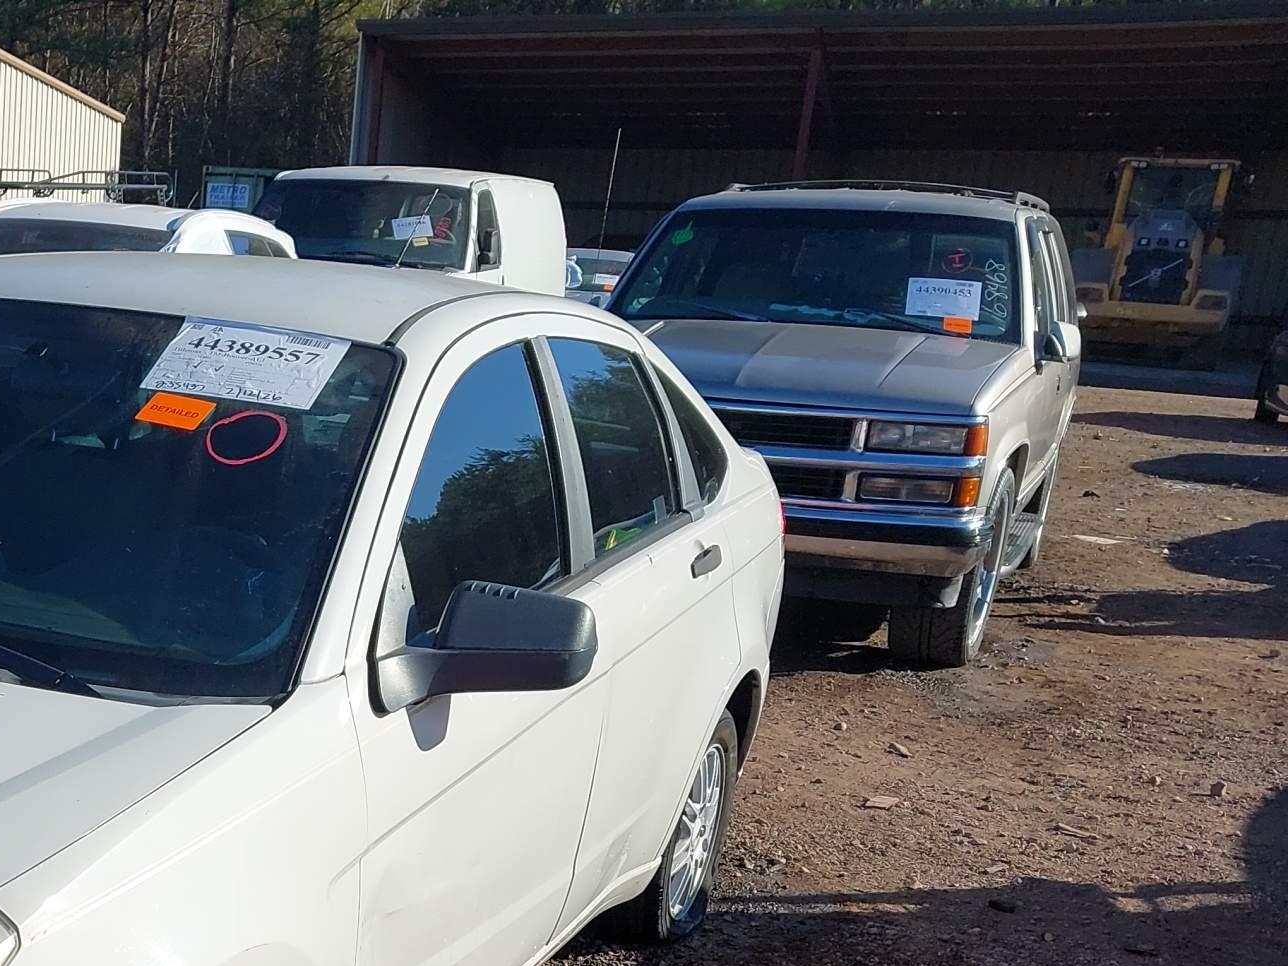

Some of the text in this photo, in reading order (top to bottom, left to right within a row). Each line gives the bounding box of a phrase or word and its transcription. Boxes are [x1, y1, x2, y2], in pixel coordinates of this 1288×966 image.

[209, 184, 248, 194] METRO
[915, 285, 973, 298] 44390453
[187, 336, 321, 365] 44389557
[224, 385, 284, 401] 2/12/26
[149, 403, 200, 419] DETAILED
